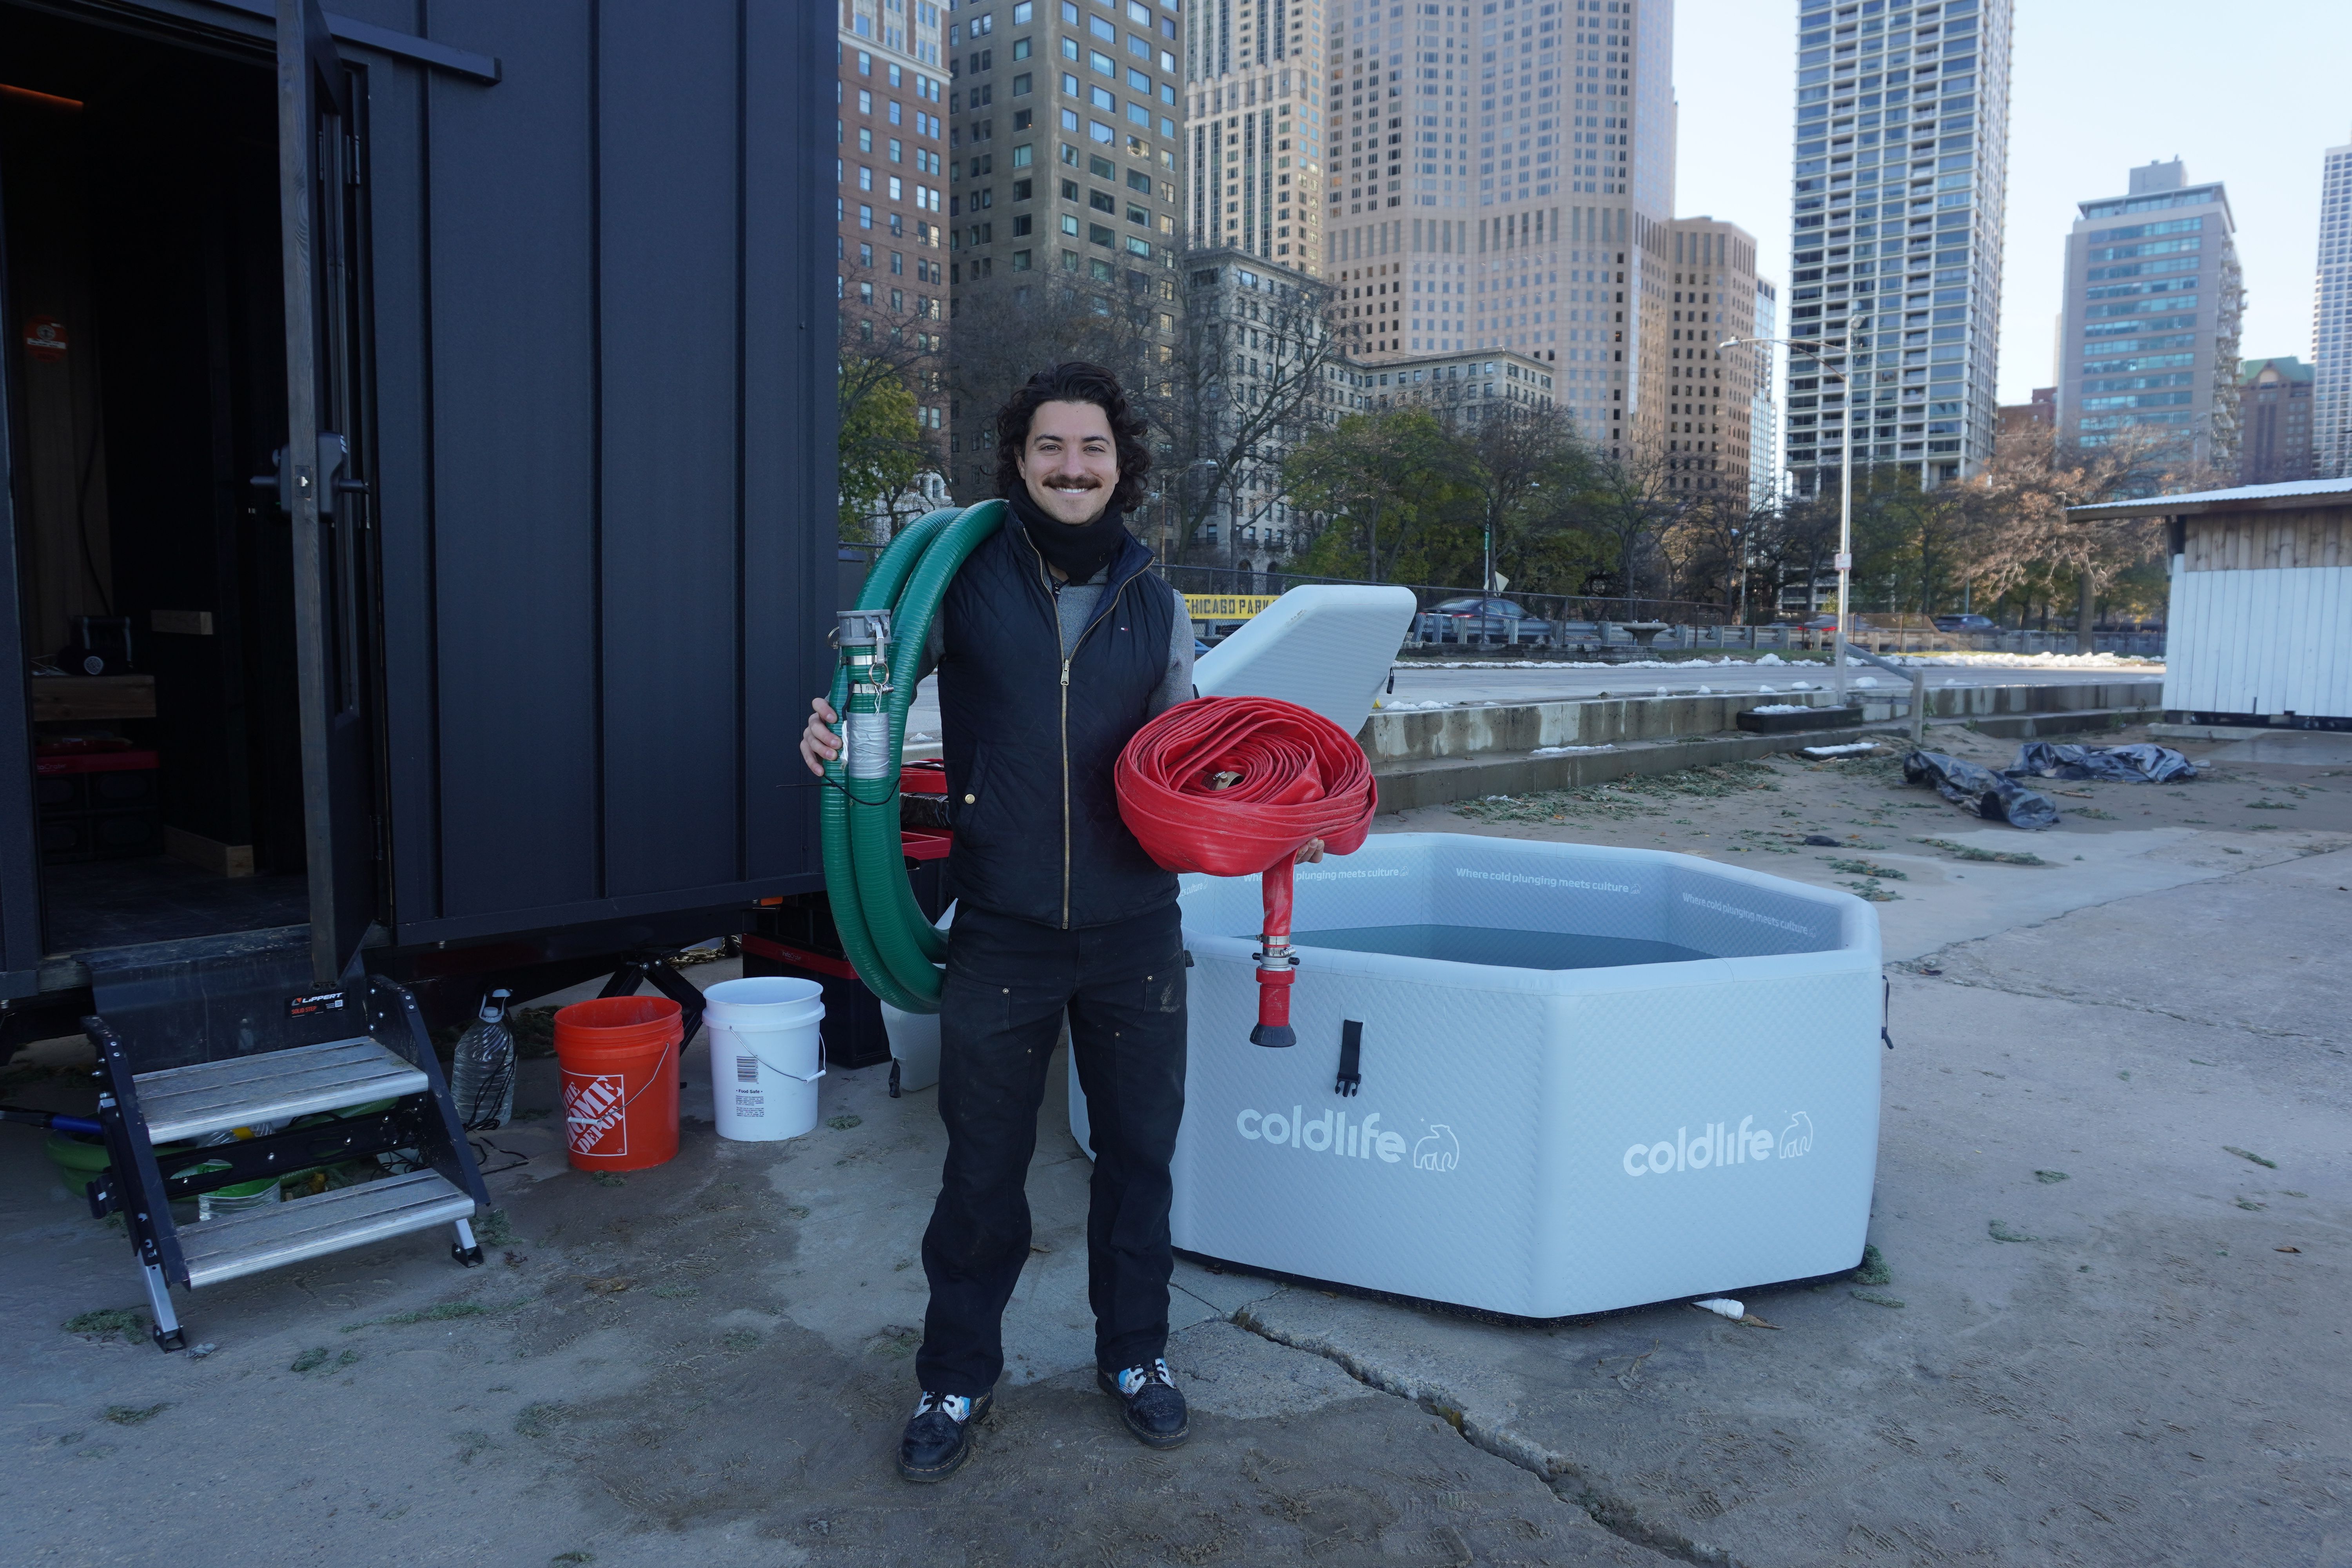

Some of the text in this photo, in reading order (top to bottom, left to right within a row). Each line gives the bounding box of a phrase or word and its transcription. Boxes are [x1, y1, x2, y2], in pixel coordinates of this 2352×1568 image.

[1187, 883, 1203, 895] culture
[1244, 868, 1399, 882] Whe plunging meets culture
[1456, 867, 1629, 893] Where cold plunging meets culture
[1682, 892, 1808, 935] Where cold plunging meets culture
[577, 1105, 624, 1153] DEPOT
[1236, 1105, 1406, 1163] coldlife
[1623, 1114, 1774, 1177] coldlife
